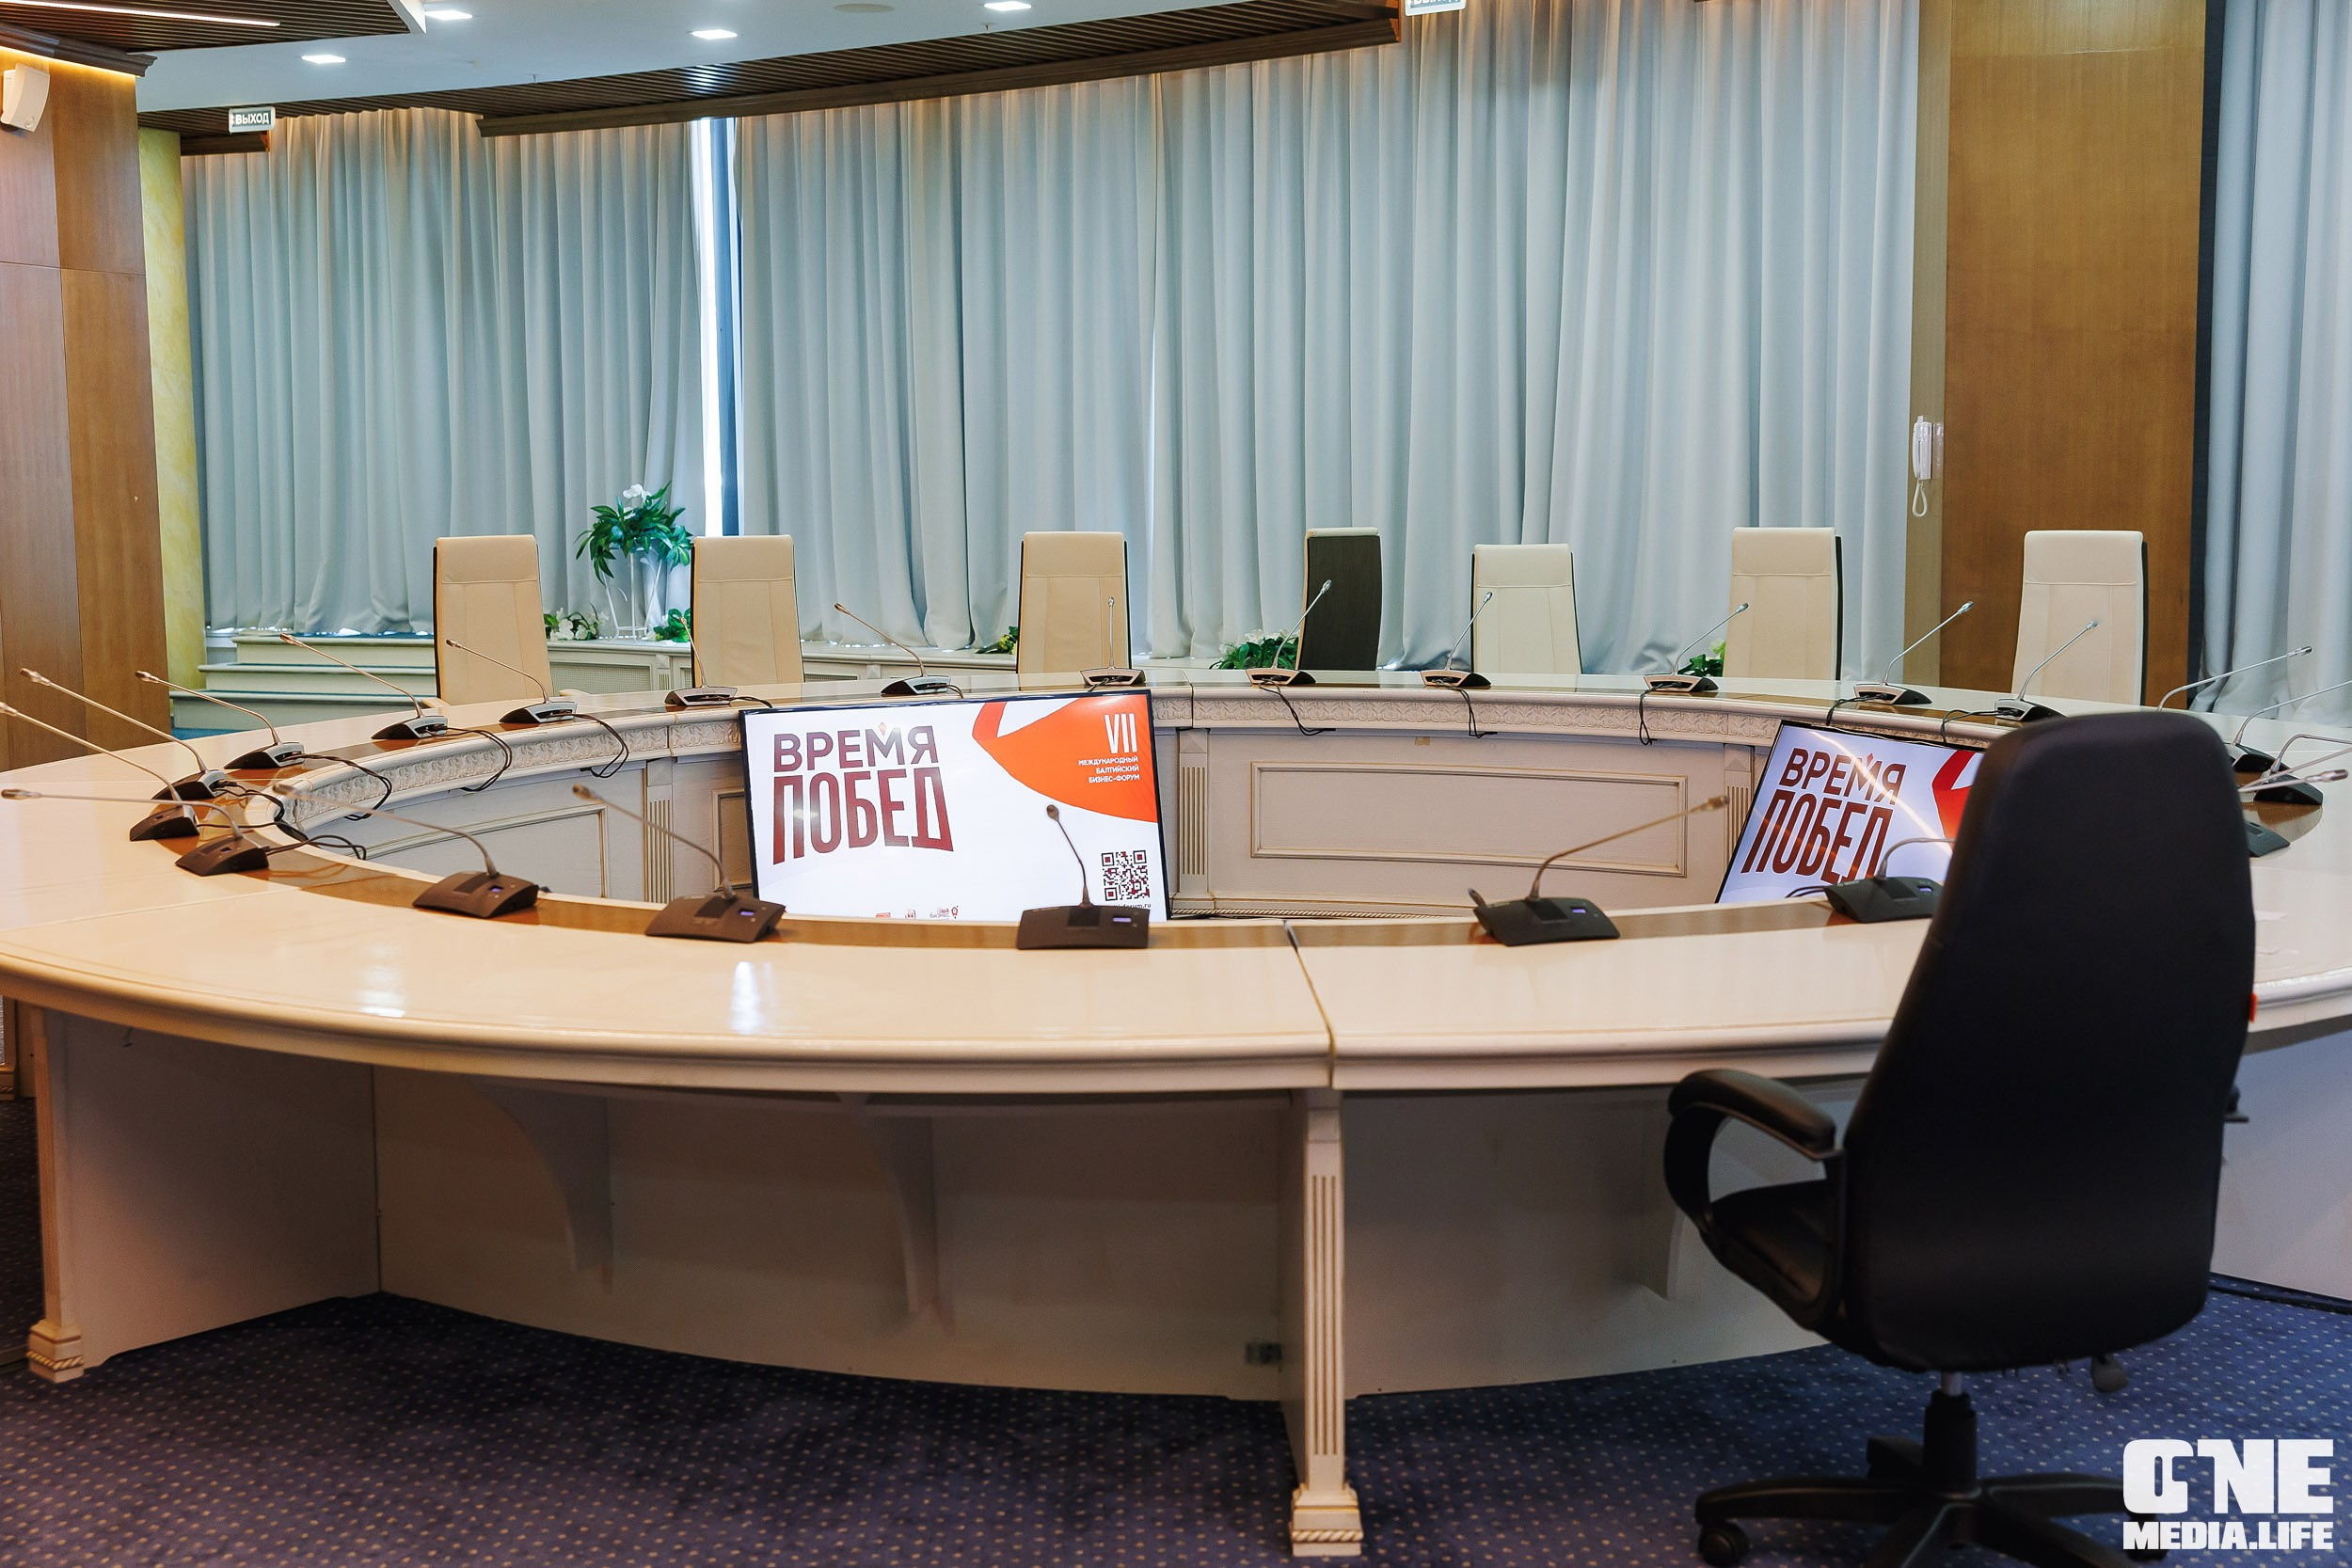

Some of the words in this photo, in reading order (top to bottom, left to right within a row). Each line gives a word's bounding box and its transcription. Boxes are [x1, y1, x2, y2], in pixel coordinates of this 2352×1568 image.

[235, 113, 269, 125] ВЫХОД
[773, 725, 939, 772] ВРЕМЯ
[1104, 713, 1137, 753] VII
[1078, 755, 1138, 766] МЕЖДУНАРОДНЫЙ
[1089, 774, 1140, 784] БИЗНЕС-ФОРУМ
[1096, 764, 1139, 774] БАЛТИЙСКИЙ
[1779, 747, 1906, 805] ВРЕМЯ
[772, 767, 954, 865] ПОБЕД
[1740, 789, 1893, 884] ПОБЕД
